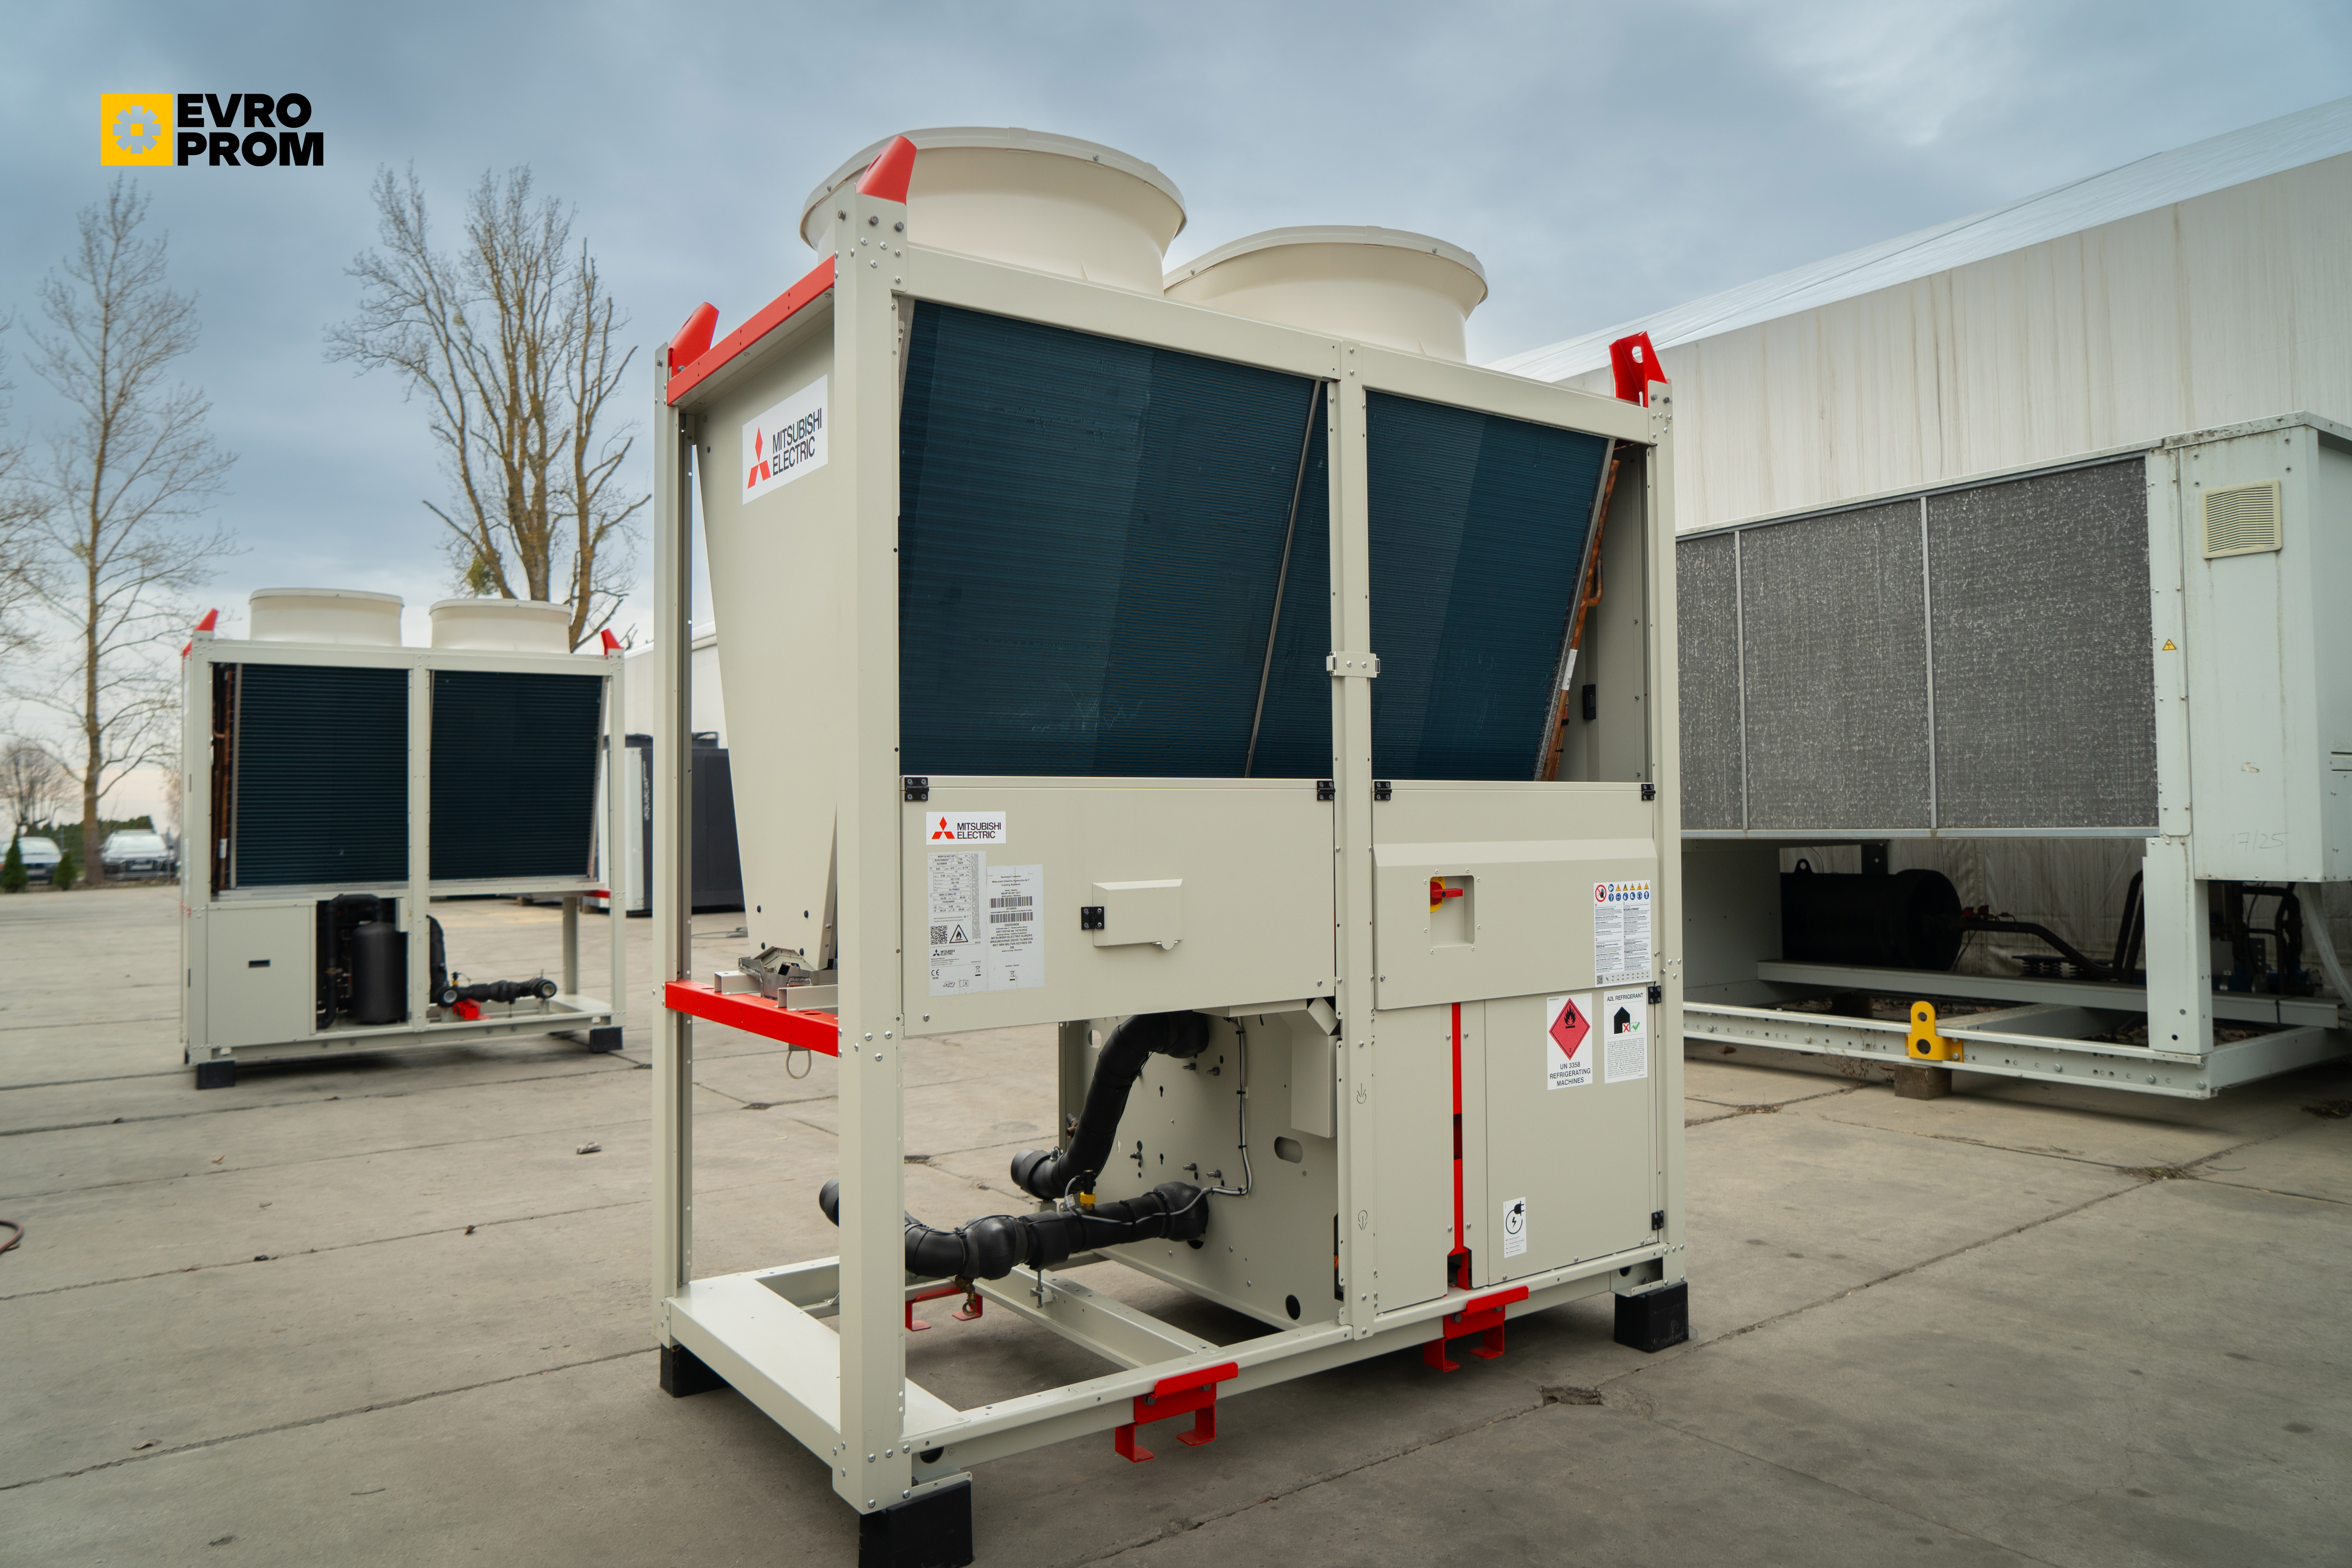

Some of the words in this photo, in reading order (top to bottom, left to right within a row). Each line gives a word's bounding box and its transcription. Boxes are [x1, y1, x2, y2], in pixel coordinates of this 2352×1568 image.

[773, 407, 822, 454] MITSUBISHI
[773, 436, 815, 476] ELECTRIC
[957, 822, 1001, 831] MITSUBISHI
[957, 831, 996, 839] ELECTRIC
[1550, 1068, 1591, 1080] REFRIGERATING
[1557, 1077, 1584, 1087] MACHINES
